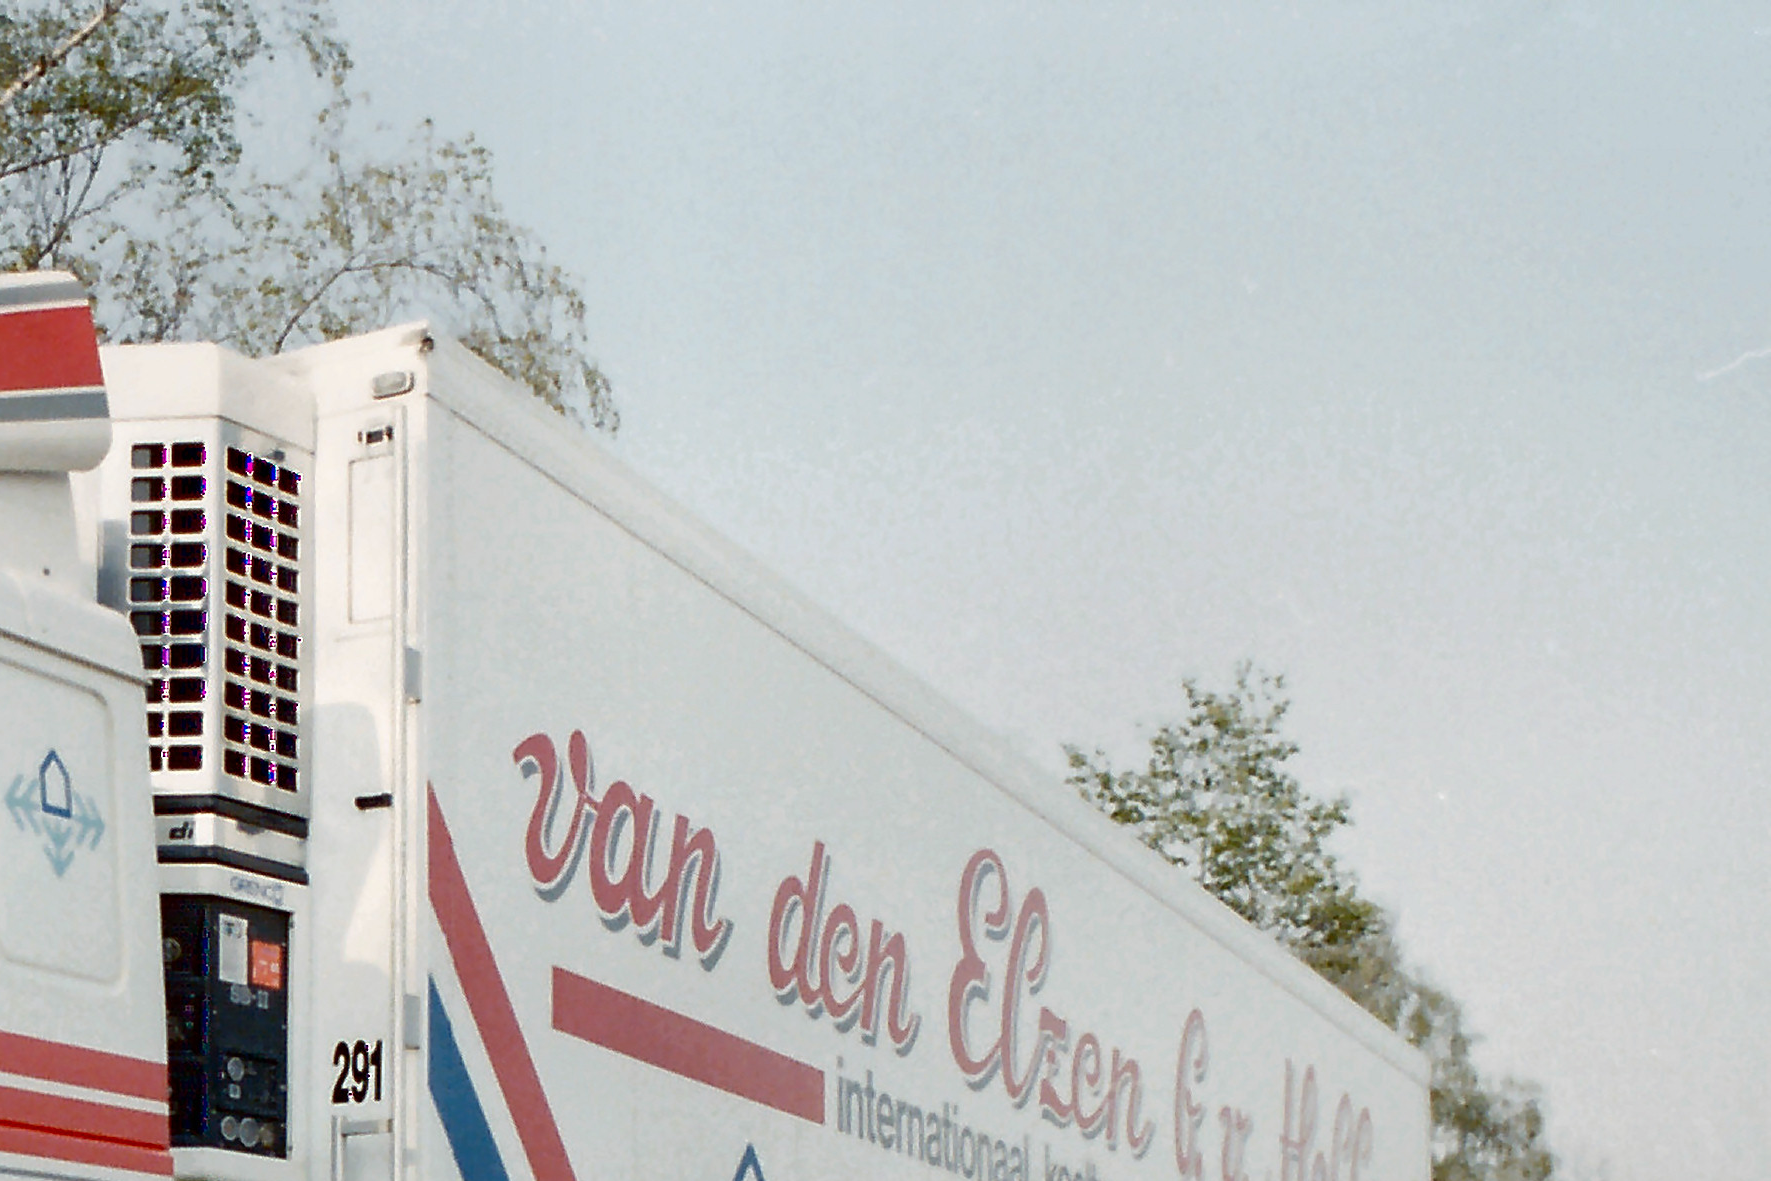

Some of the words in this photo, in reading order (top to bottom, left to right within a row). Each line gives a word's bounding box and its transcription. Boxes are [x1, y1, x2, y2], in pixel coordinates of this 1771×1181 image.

[331, 1039, 383, 1104] 291
[768, 841, 920, 1056] den
[948, 848, 1156, 1159] Elzen
